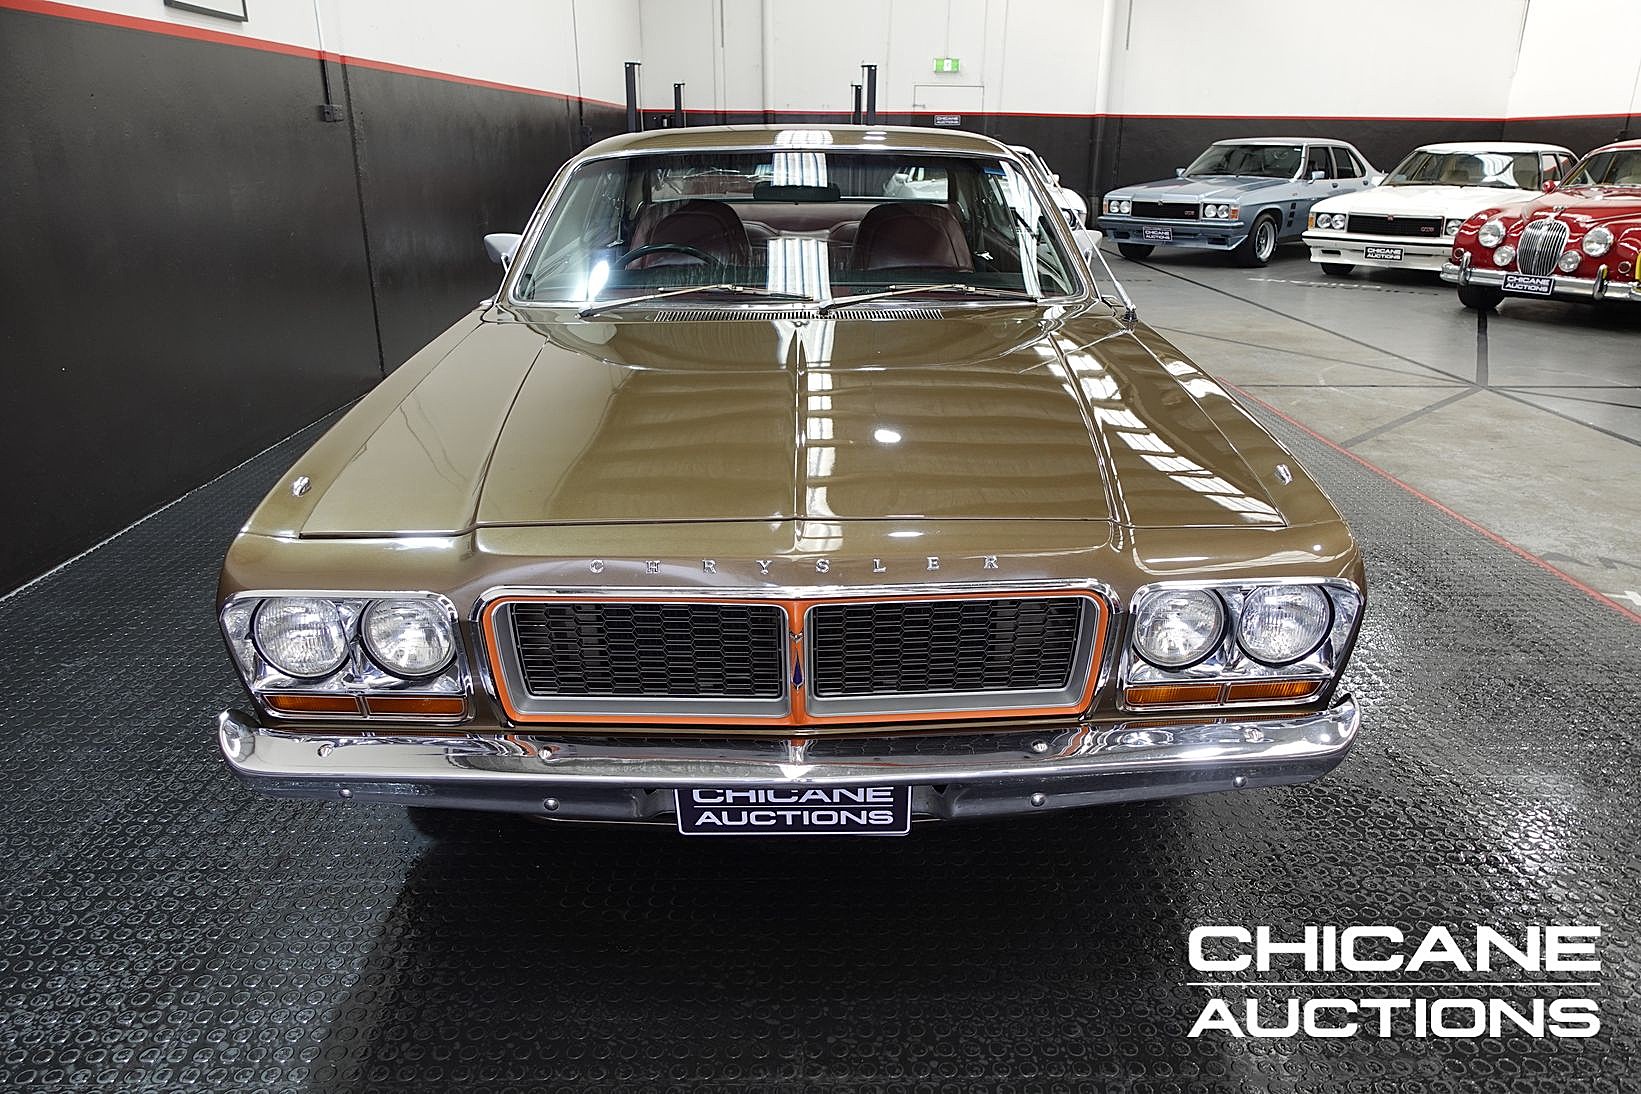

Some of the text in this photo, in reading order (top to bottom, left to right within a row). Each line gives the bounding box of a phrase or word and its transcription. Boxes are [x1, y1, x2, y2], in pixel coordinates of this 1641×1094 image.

[1505, 282, 1548, 292] AUCTIONS
[1507, 275, 1550, 286] CHICANE
[589, 555, 1000, 575] CHRYSLER
[692, 787, 894, 803] CHICANE
[694, 810, 894, 826] AUCTIONS
